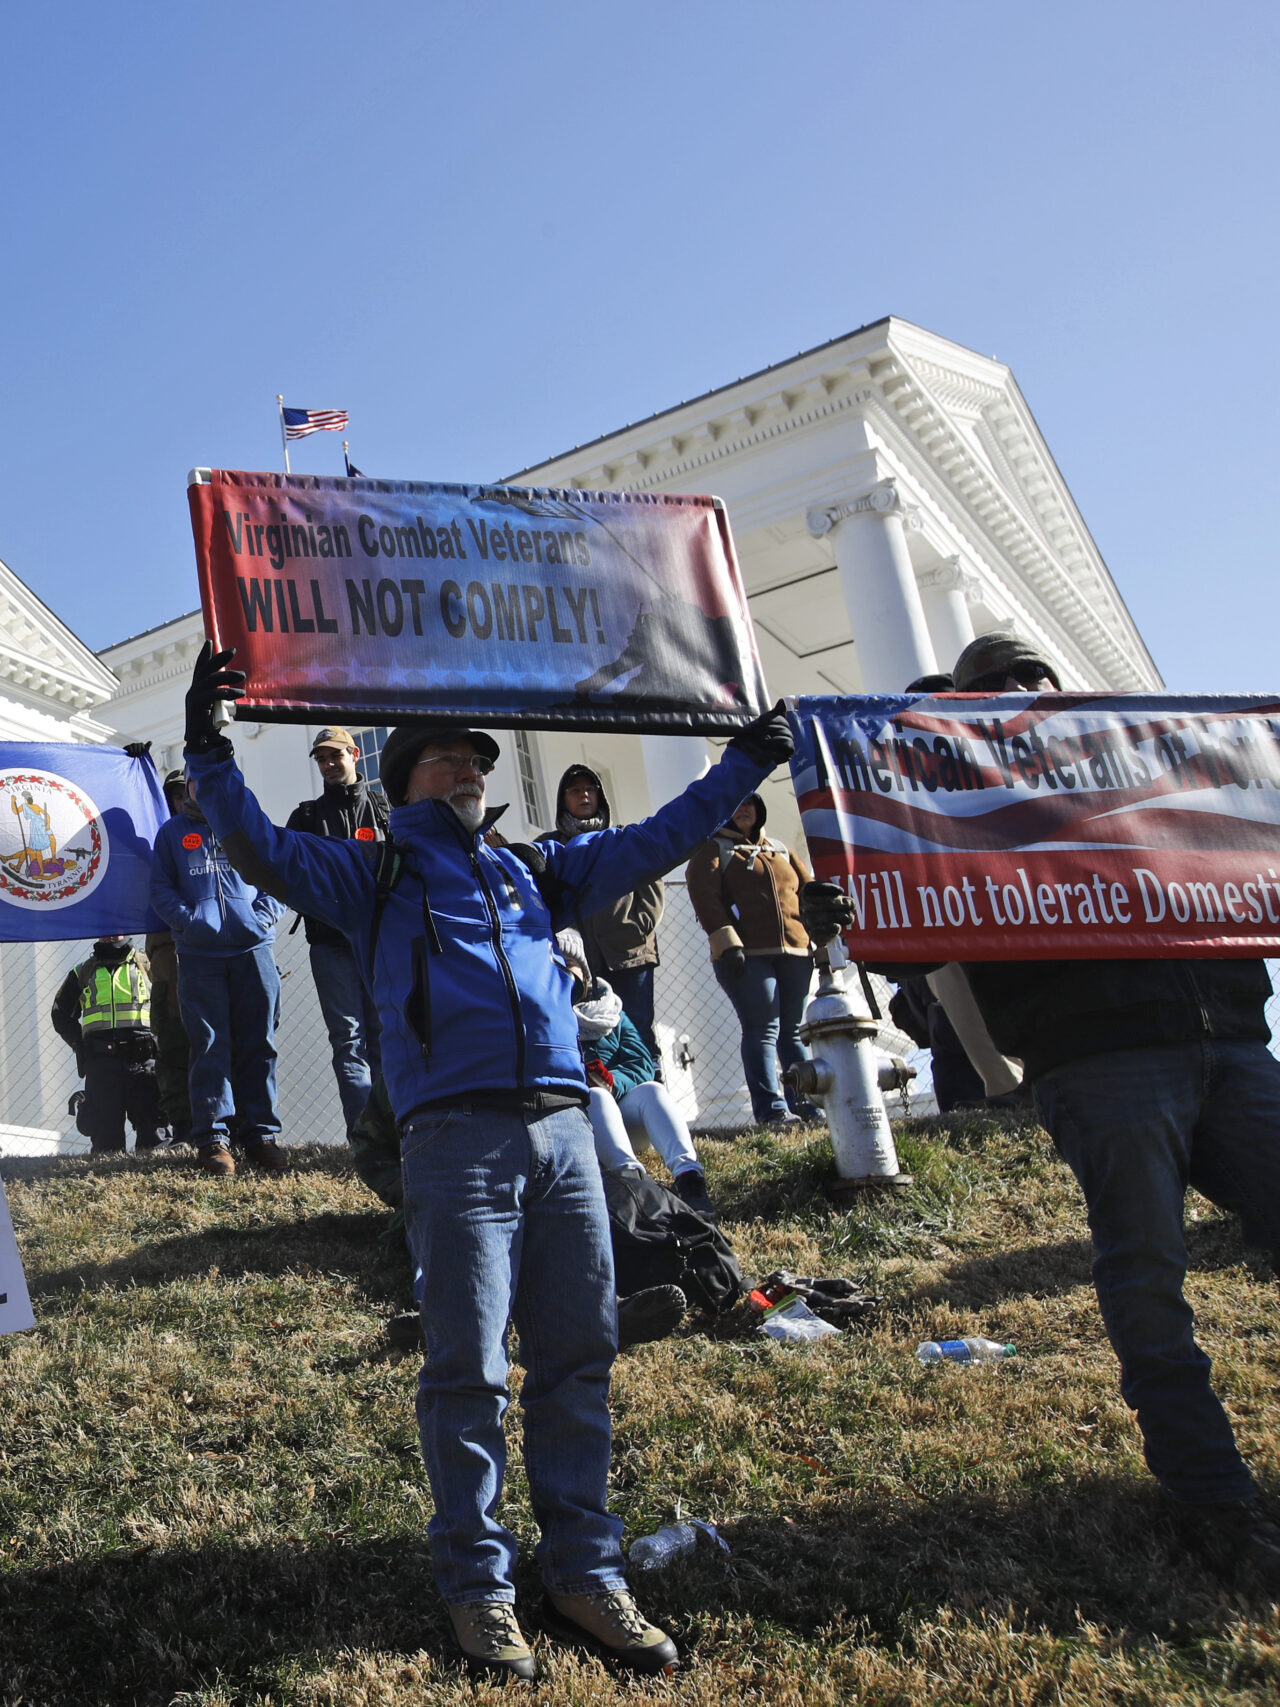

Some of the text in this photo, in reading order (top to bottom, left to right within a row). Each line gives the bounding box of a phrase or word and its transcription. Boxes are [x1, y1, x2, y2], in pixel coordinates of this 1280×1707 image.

[224, 510, 591, 570] Virginian Combat Veterans
[237, 576, 606, 644] WILL NOT COMPLY!
[976, 718, 1153, 790] Veterans
[1154, 718, 1199, 790] of
[4, 785, 53, 795] VIRGINIA
[48, 866, 83, 889] TYRANNIS
[829, 870, 912, 930] Will
[917, 876, 983, 927] not
[985, 868, 1132, 926] tolerate
